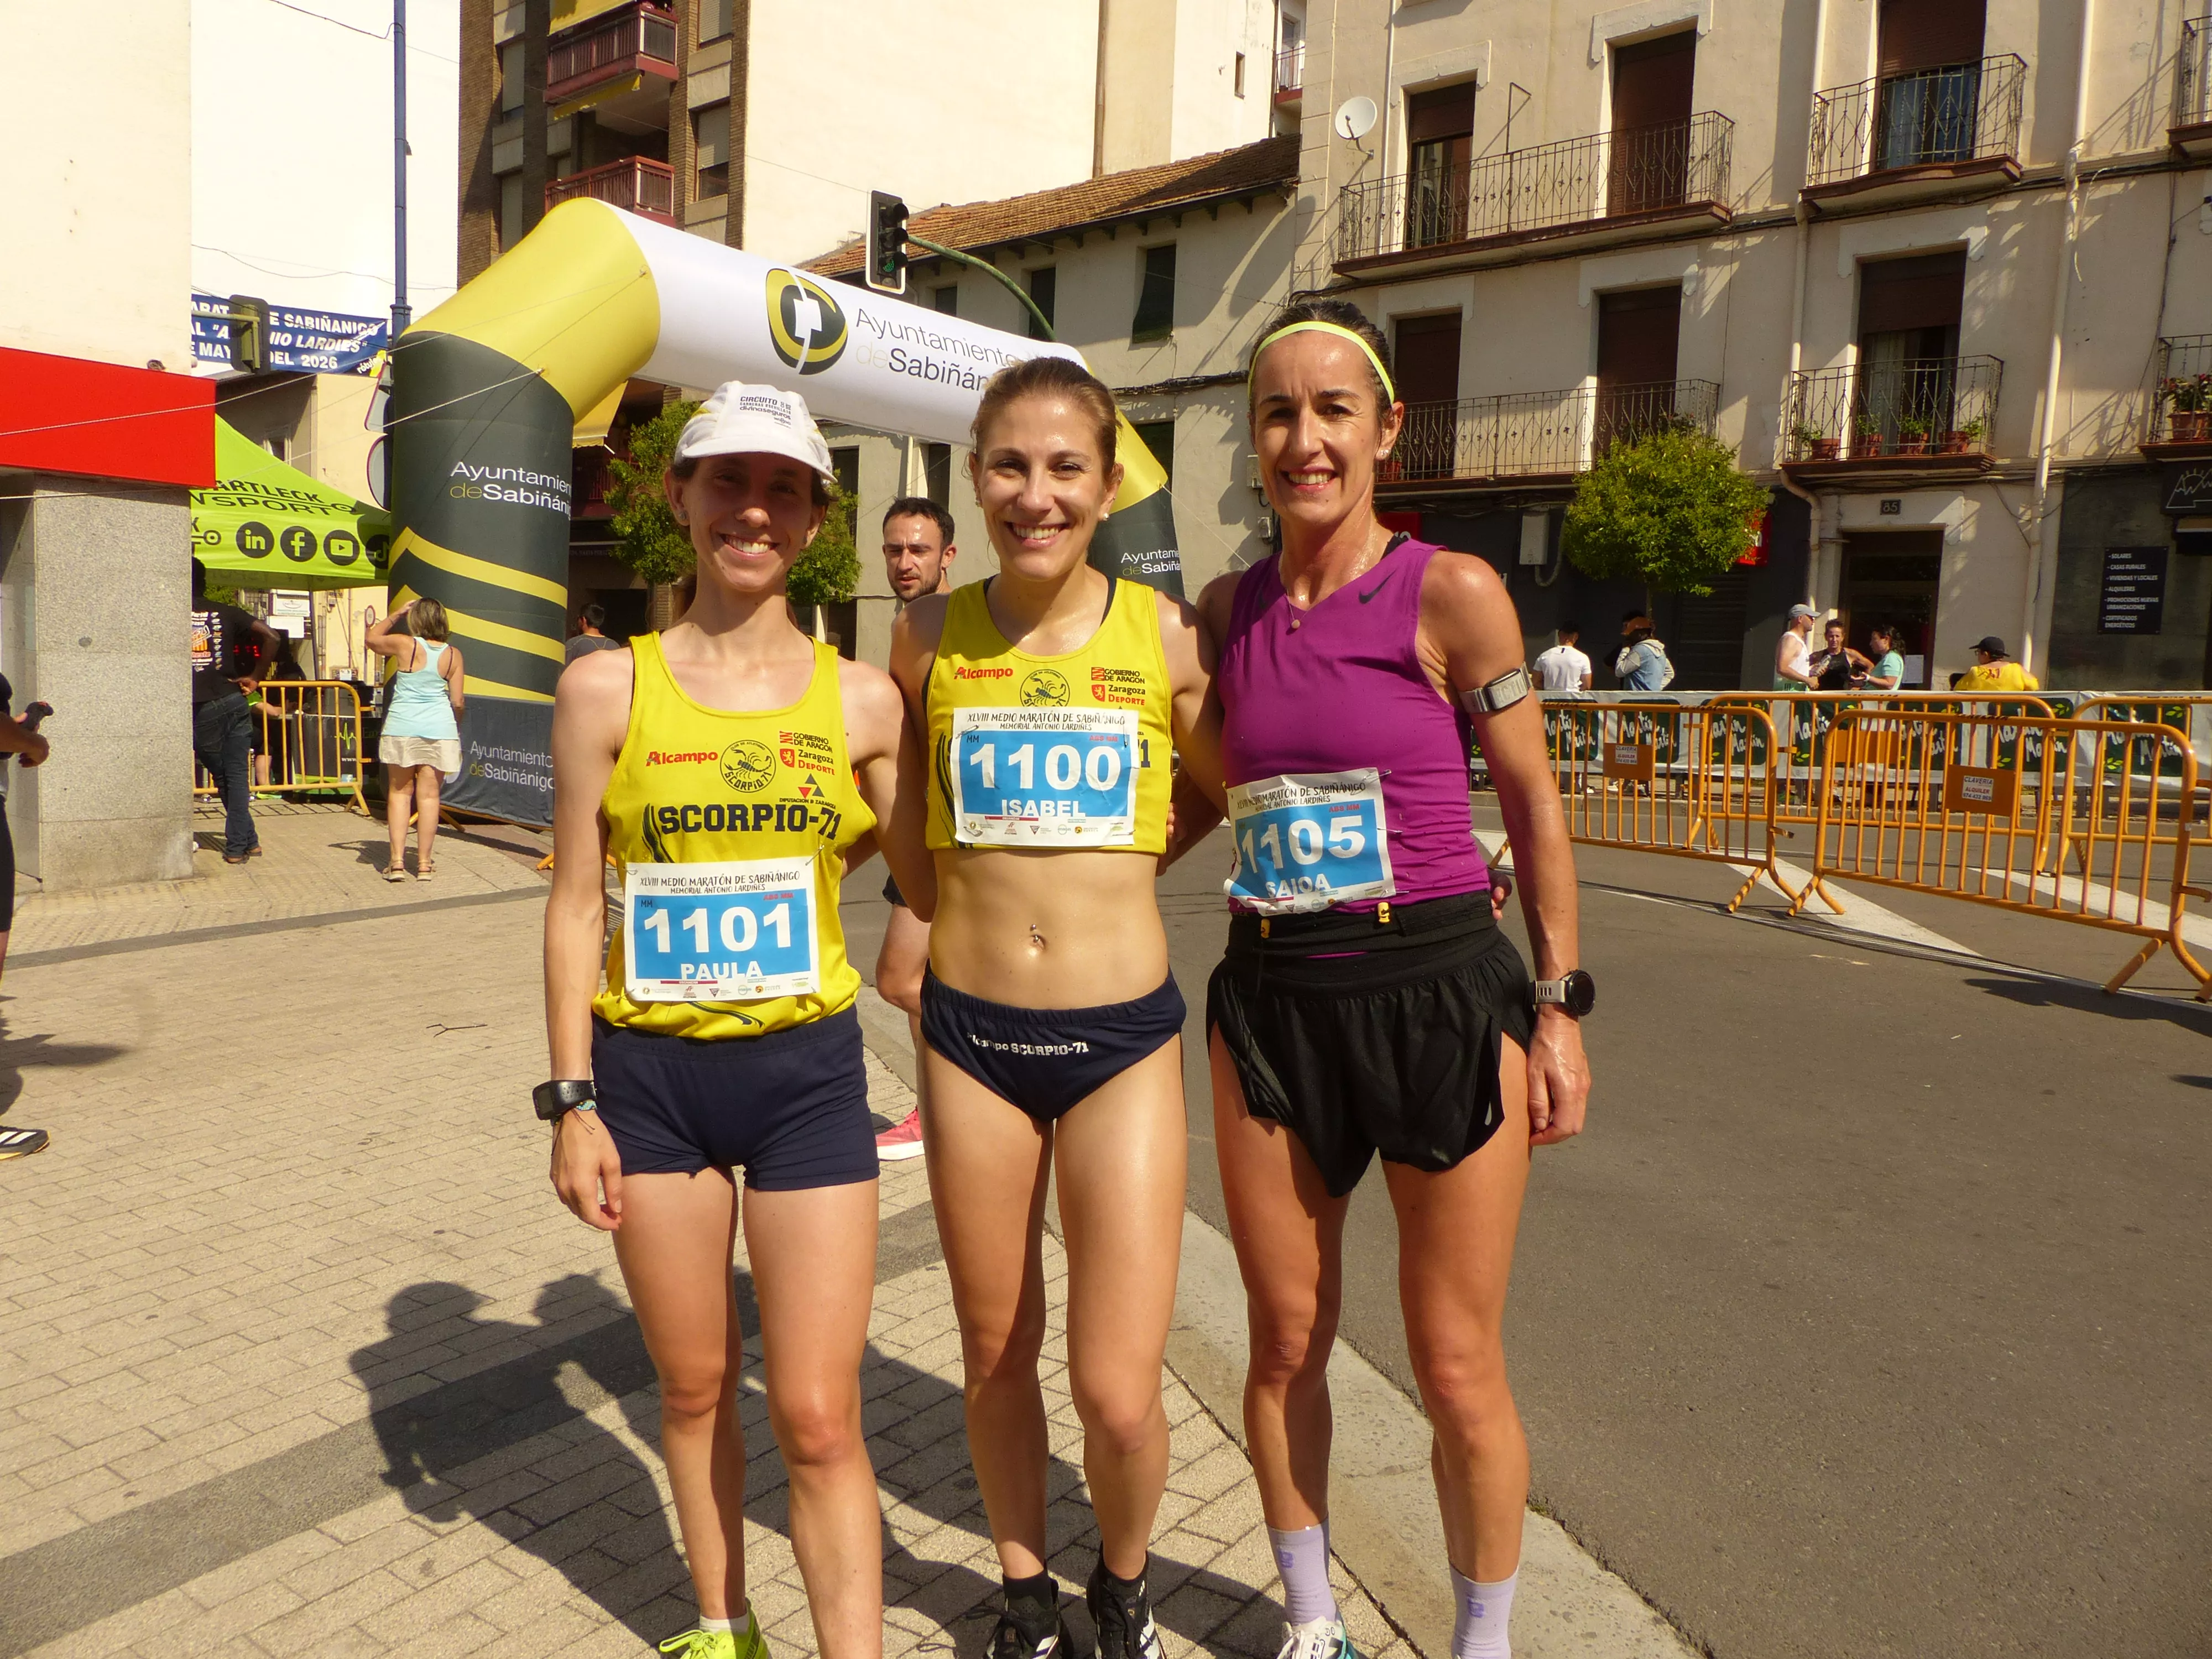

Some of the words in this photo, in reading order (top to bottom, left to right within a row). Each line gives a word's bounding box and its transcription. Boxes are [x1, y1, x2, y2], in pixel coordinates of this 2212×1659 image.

[301, 354, 338, 369] 2026
[740, 397, 778, 405] CIRCUITO
[1883, 502, 1898, 512] 85
[954, 666, 1013, 680] Alcampo
[1104, 669, 1140, 677] GOBIERNO
[1108, 684, 1146, 696] Zaragoza
[1108, 694, 1145, 706] DEPORTE
[967, 713, 989, 722] XLVIII
[991, 713, 1017, 722] MEDIO
[1019, 711, 1060, 723] MARATÓN
[1063, 713, 1074, 722] DE
[793, 732, 829, 745] GOBIERNO
[967, 735, 979, 743] MM
[470, 740, 554, 768] Ayuntamiento
[645, 750, 718, 767] Alcampo
[798, 749, 834, 765] Zaragoza
[970, 743, 1121, 791] 1100
[1262, 785, 1297, 802] MARATÓN
[1300, 786, 1311, 797] DE
[1313, 782, 1366, 796] SABIÑÁNIGO
[815, 800, 836, 810] ZARAGOZA
[1001, 799, 1086, 818] ISABEL
[1274, 798, 1298, 808] ANTONIO
[658, 804, 842, 841] SCORPIO-71
[1241, 816, 1365, 874] 1105
[640, 877, 659, 886] XLVIII
[661, 877, 686, 886] MEDIO
[689, 873, 732, 886] MARATÓN
[735, 875, 746, 884] DE
[748, 870, 800, 884] SABIÑÁNIGO
[1265, 873, 1331, 898] SAIOA
[641, 899, 653, 908] MM
[644, 902, 791, 953] 1101
[680, 961, 764, 980] PAULA
[967, 1032, 1009, 1051] lcampo
[1010, 1041, 1089, 1056] SCORPIO-71
